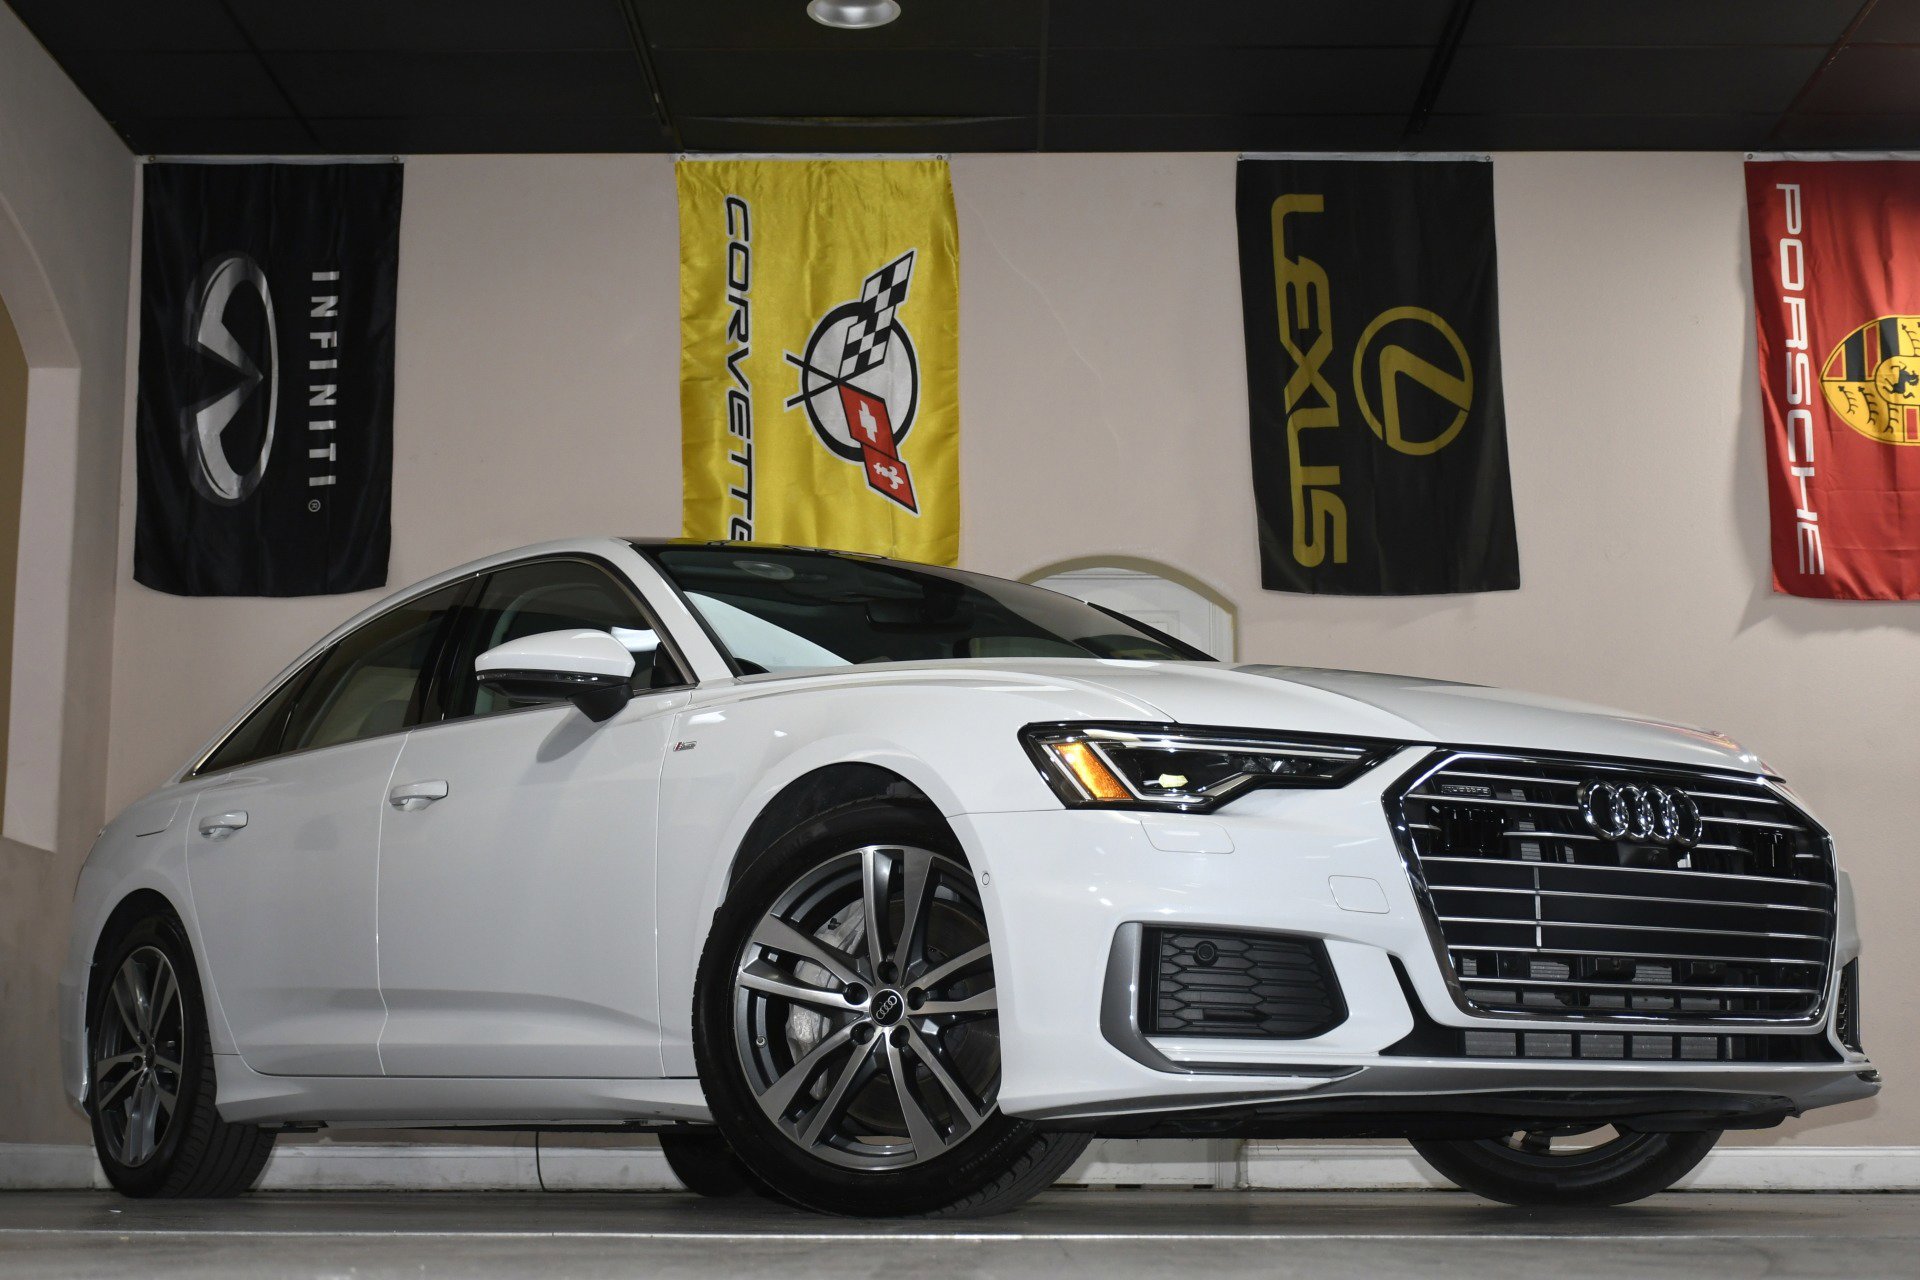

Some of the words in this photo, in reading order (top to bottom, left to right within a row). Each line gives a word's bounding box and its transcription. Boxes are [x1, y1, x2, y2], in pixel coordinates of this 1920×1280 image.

[309, 270, 339, 487] INFINITI
[1271, 193, 1348, 568] LEXUS
[1776, 183, 1825, 576] PORSCHE
